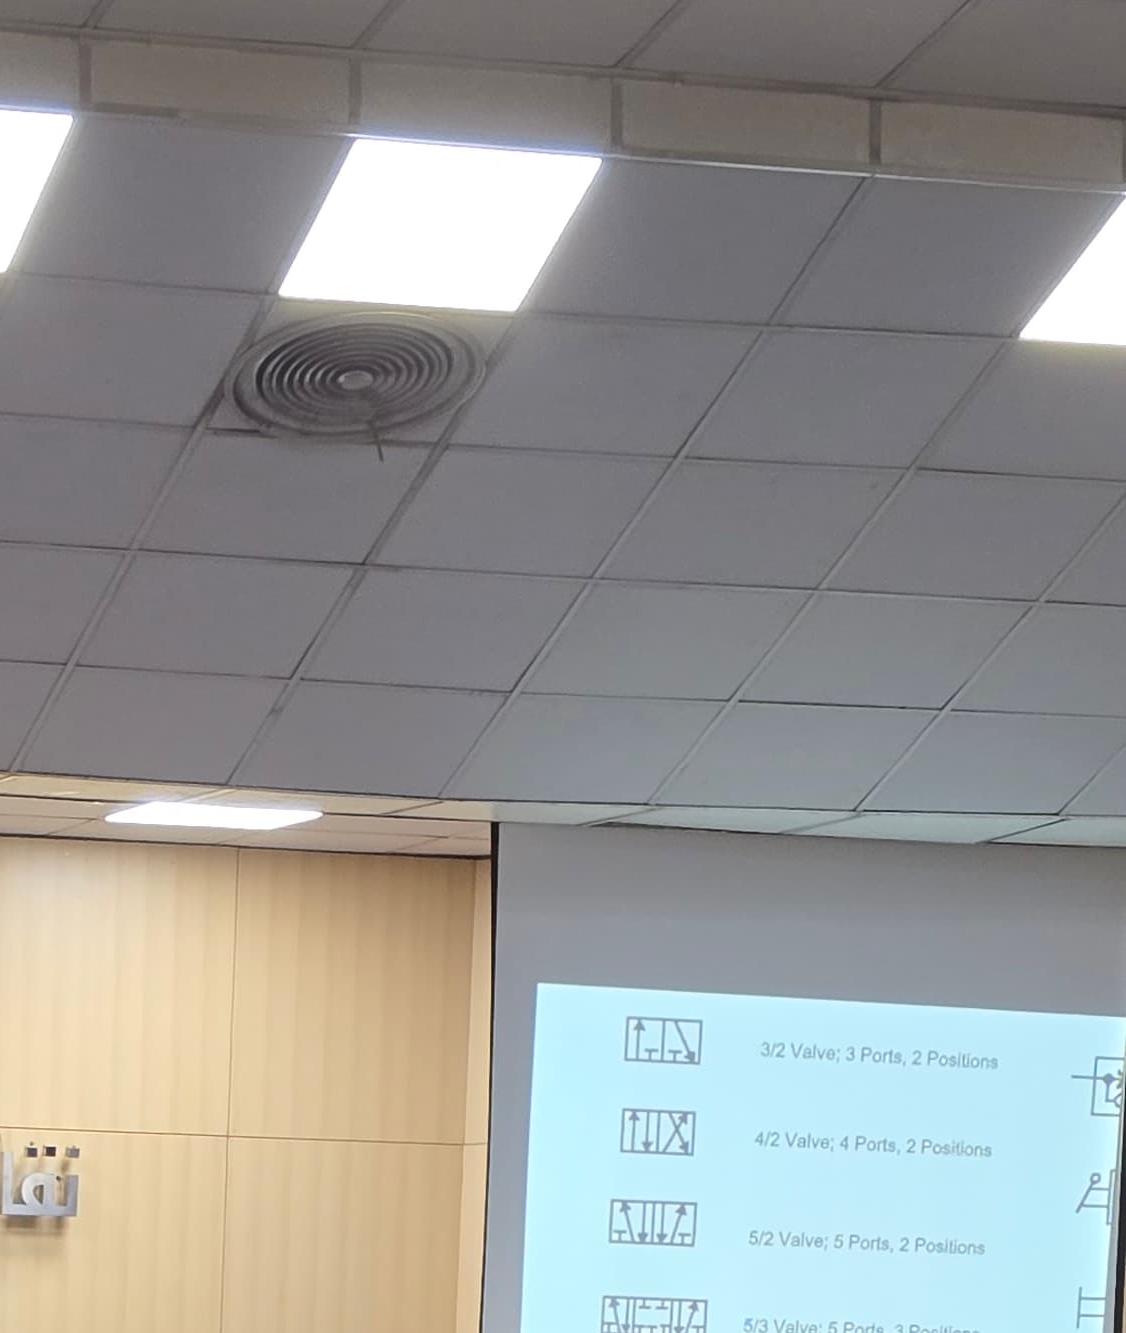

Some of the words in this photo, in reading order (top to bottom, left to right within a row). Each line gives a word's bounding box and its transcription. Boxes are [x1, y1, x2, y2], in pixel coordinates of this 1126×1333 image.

[760, 1041, 785, 1058] 3/2
[790, 1043, 841, 1063] Valve;
[845, 1046, 856, 1061] 3
[860, 1047, 907, 1067] Ports,
[911, 1050, 922, 1066] 2
[927, 1051, 998, 1070] Positions
[755, 1131, 780, 1147] 4/2
[785, 1132, 835, 1152] Valve;
[839, 1136, 850, 1151] 4
[855, 1136, 901, 1155] Ports,
[905, 1139, 916, 1154] 2
[921, 1139, 992, 1157] Positions
[748, 1230, 774, 1246] 5/2
[778, 1231, 828, 1251] Valve;
[833, 1234, 844, 1249] 5
[848, 1234, 894, 1254] Ports,
[899, 1237, 910, 1252] 2
[915, 1237, 985, 1256] Positions
[743, 1318, 768, 1333] 5/3
